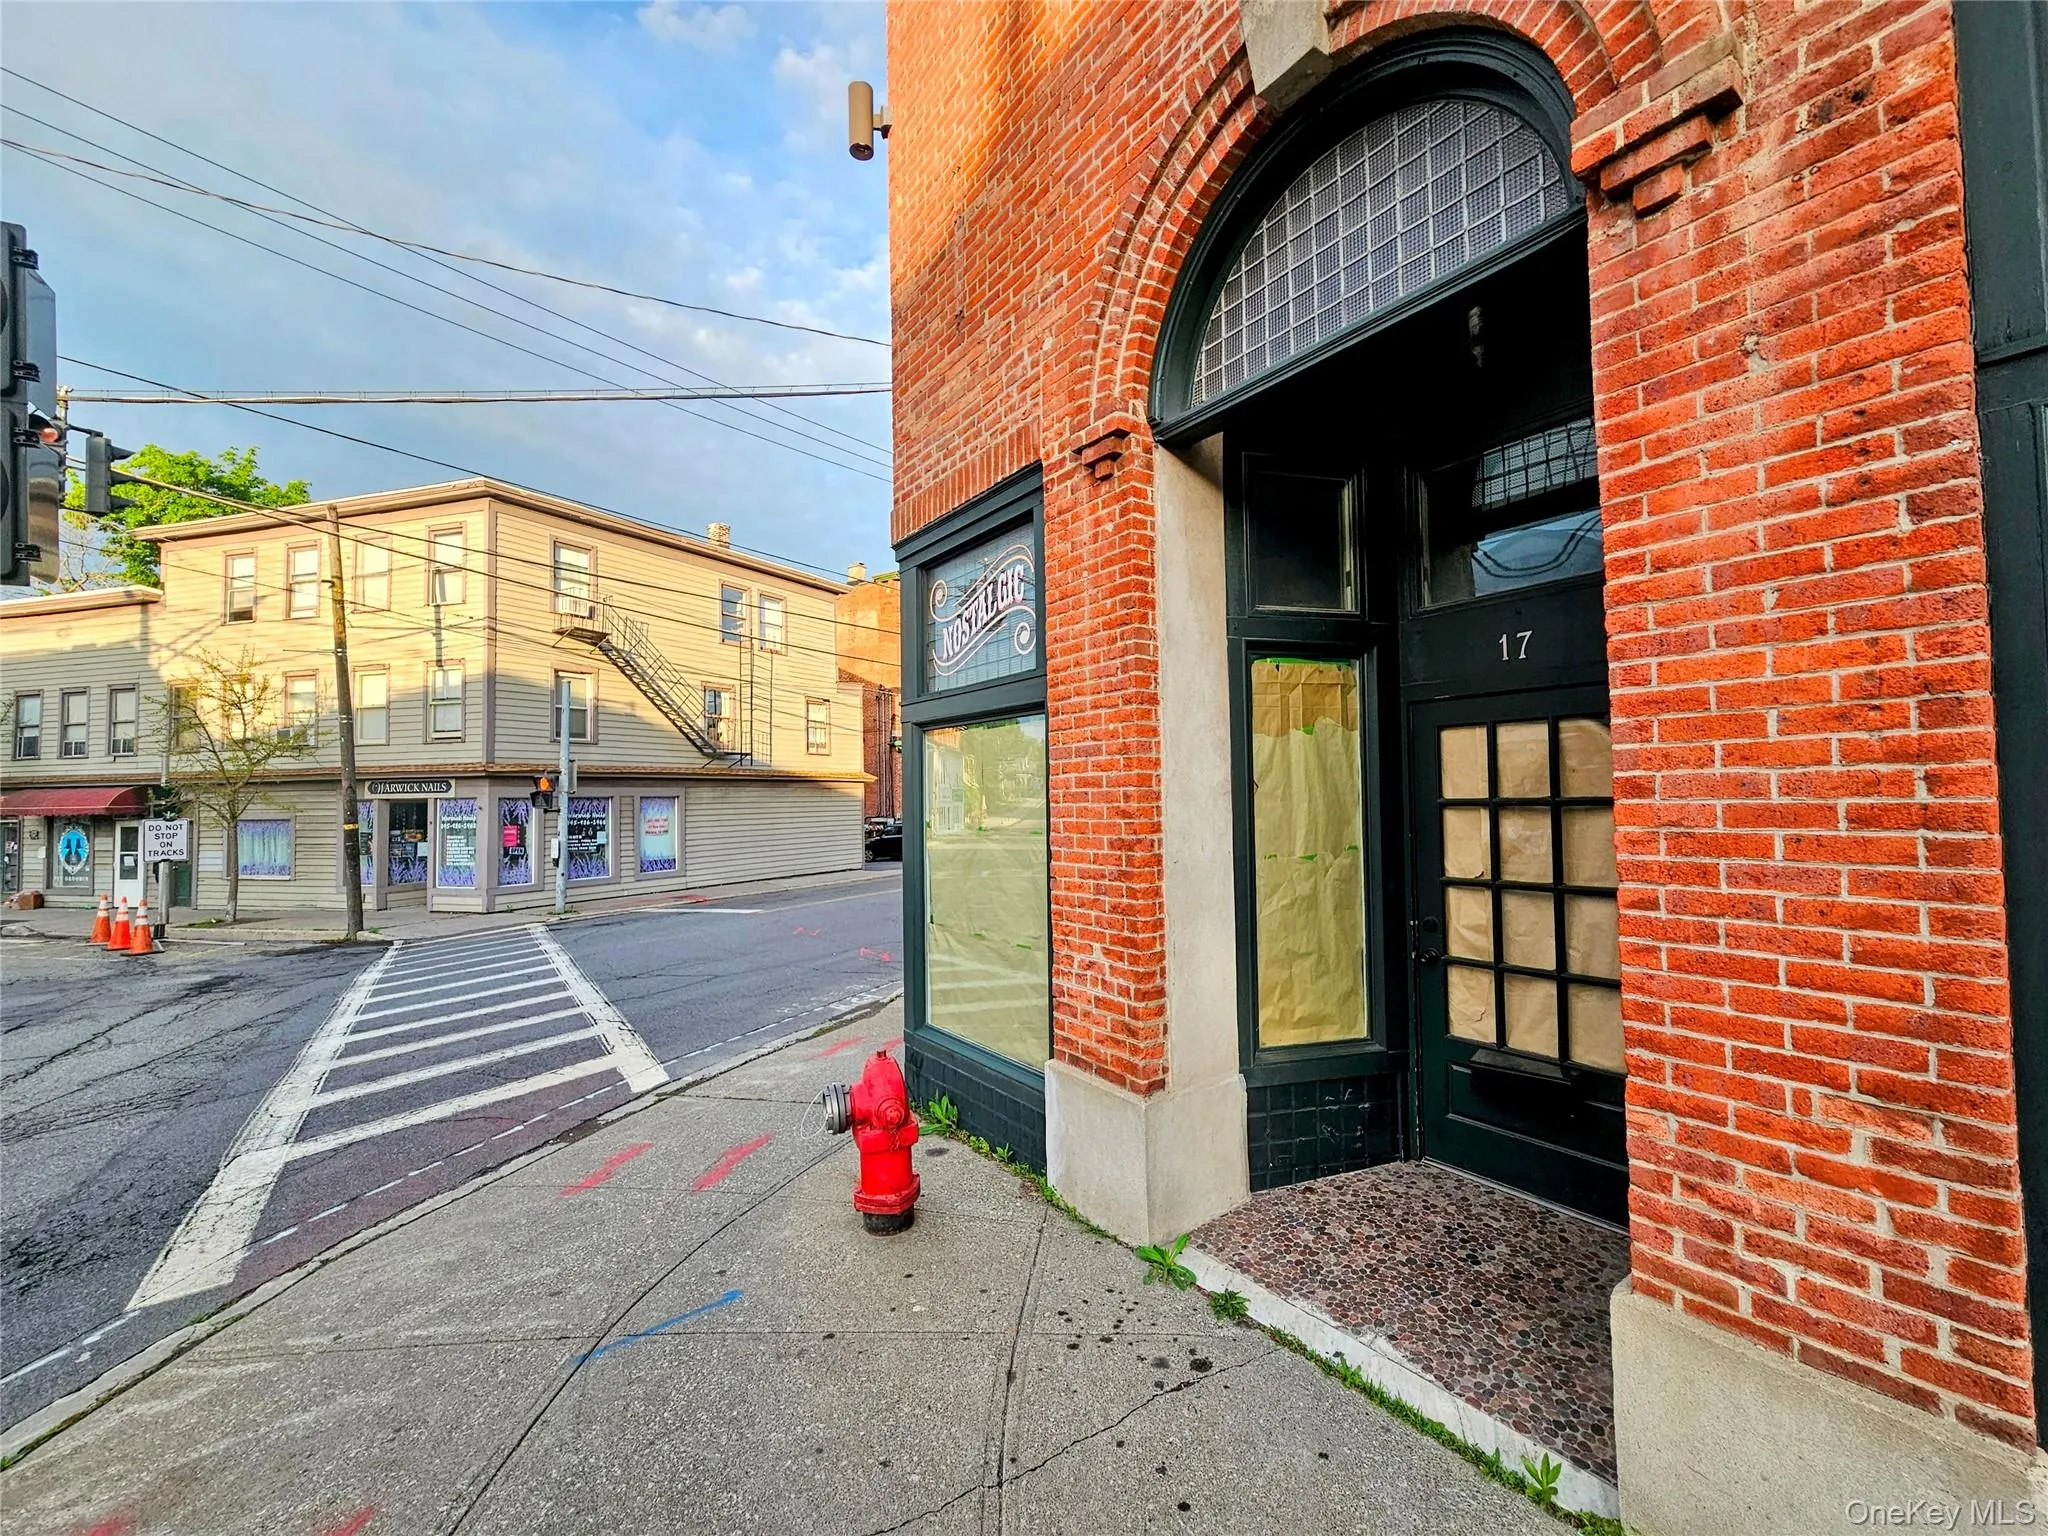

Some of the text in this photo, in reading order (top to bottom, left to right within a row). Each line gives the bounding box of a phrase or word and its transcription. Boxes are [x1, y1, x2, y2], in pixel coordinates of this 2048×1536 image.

[943, 564, 1025, 660] NOSTALGIC
[1498, 630, 1533, 661] 17
[372, 782, 447, 794] WARWICK NAILS
[148, 823, 184, 832] DO NOT
[154, 832, 179, 840] STOP
[148, 849, 185, 857] TRACKS
